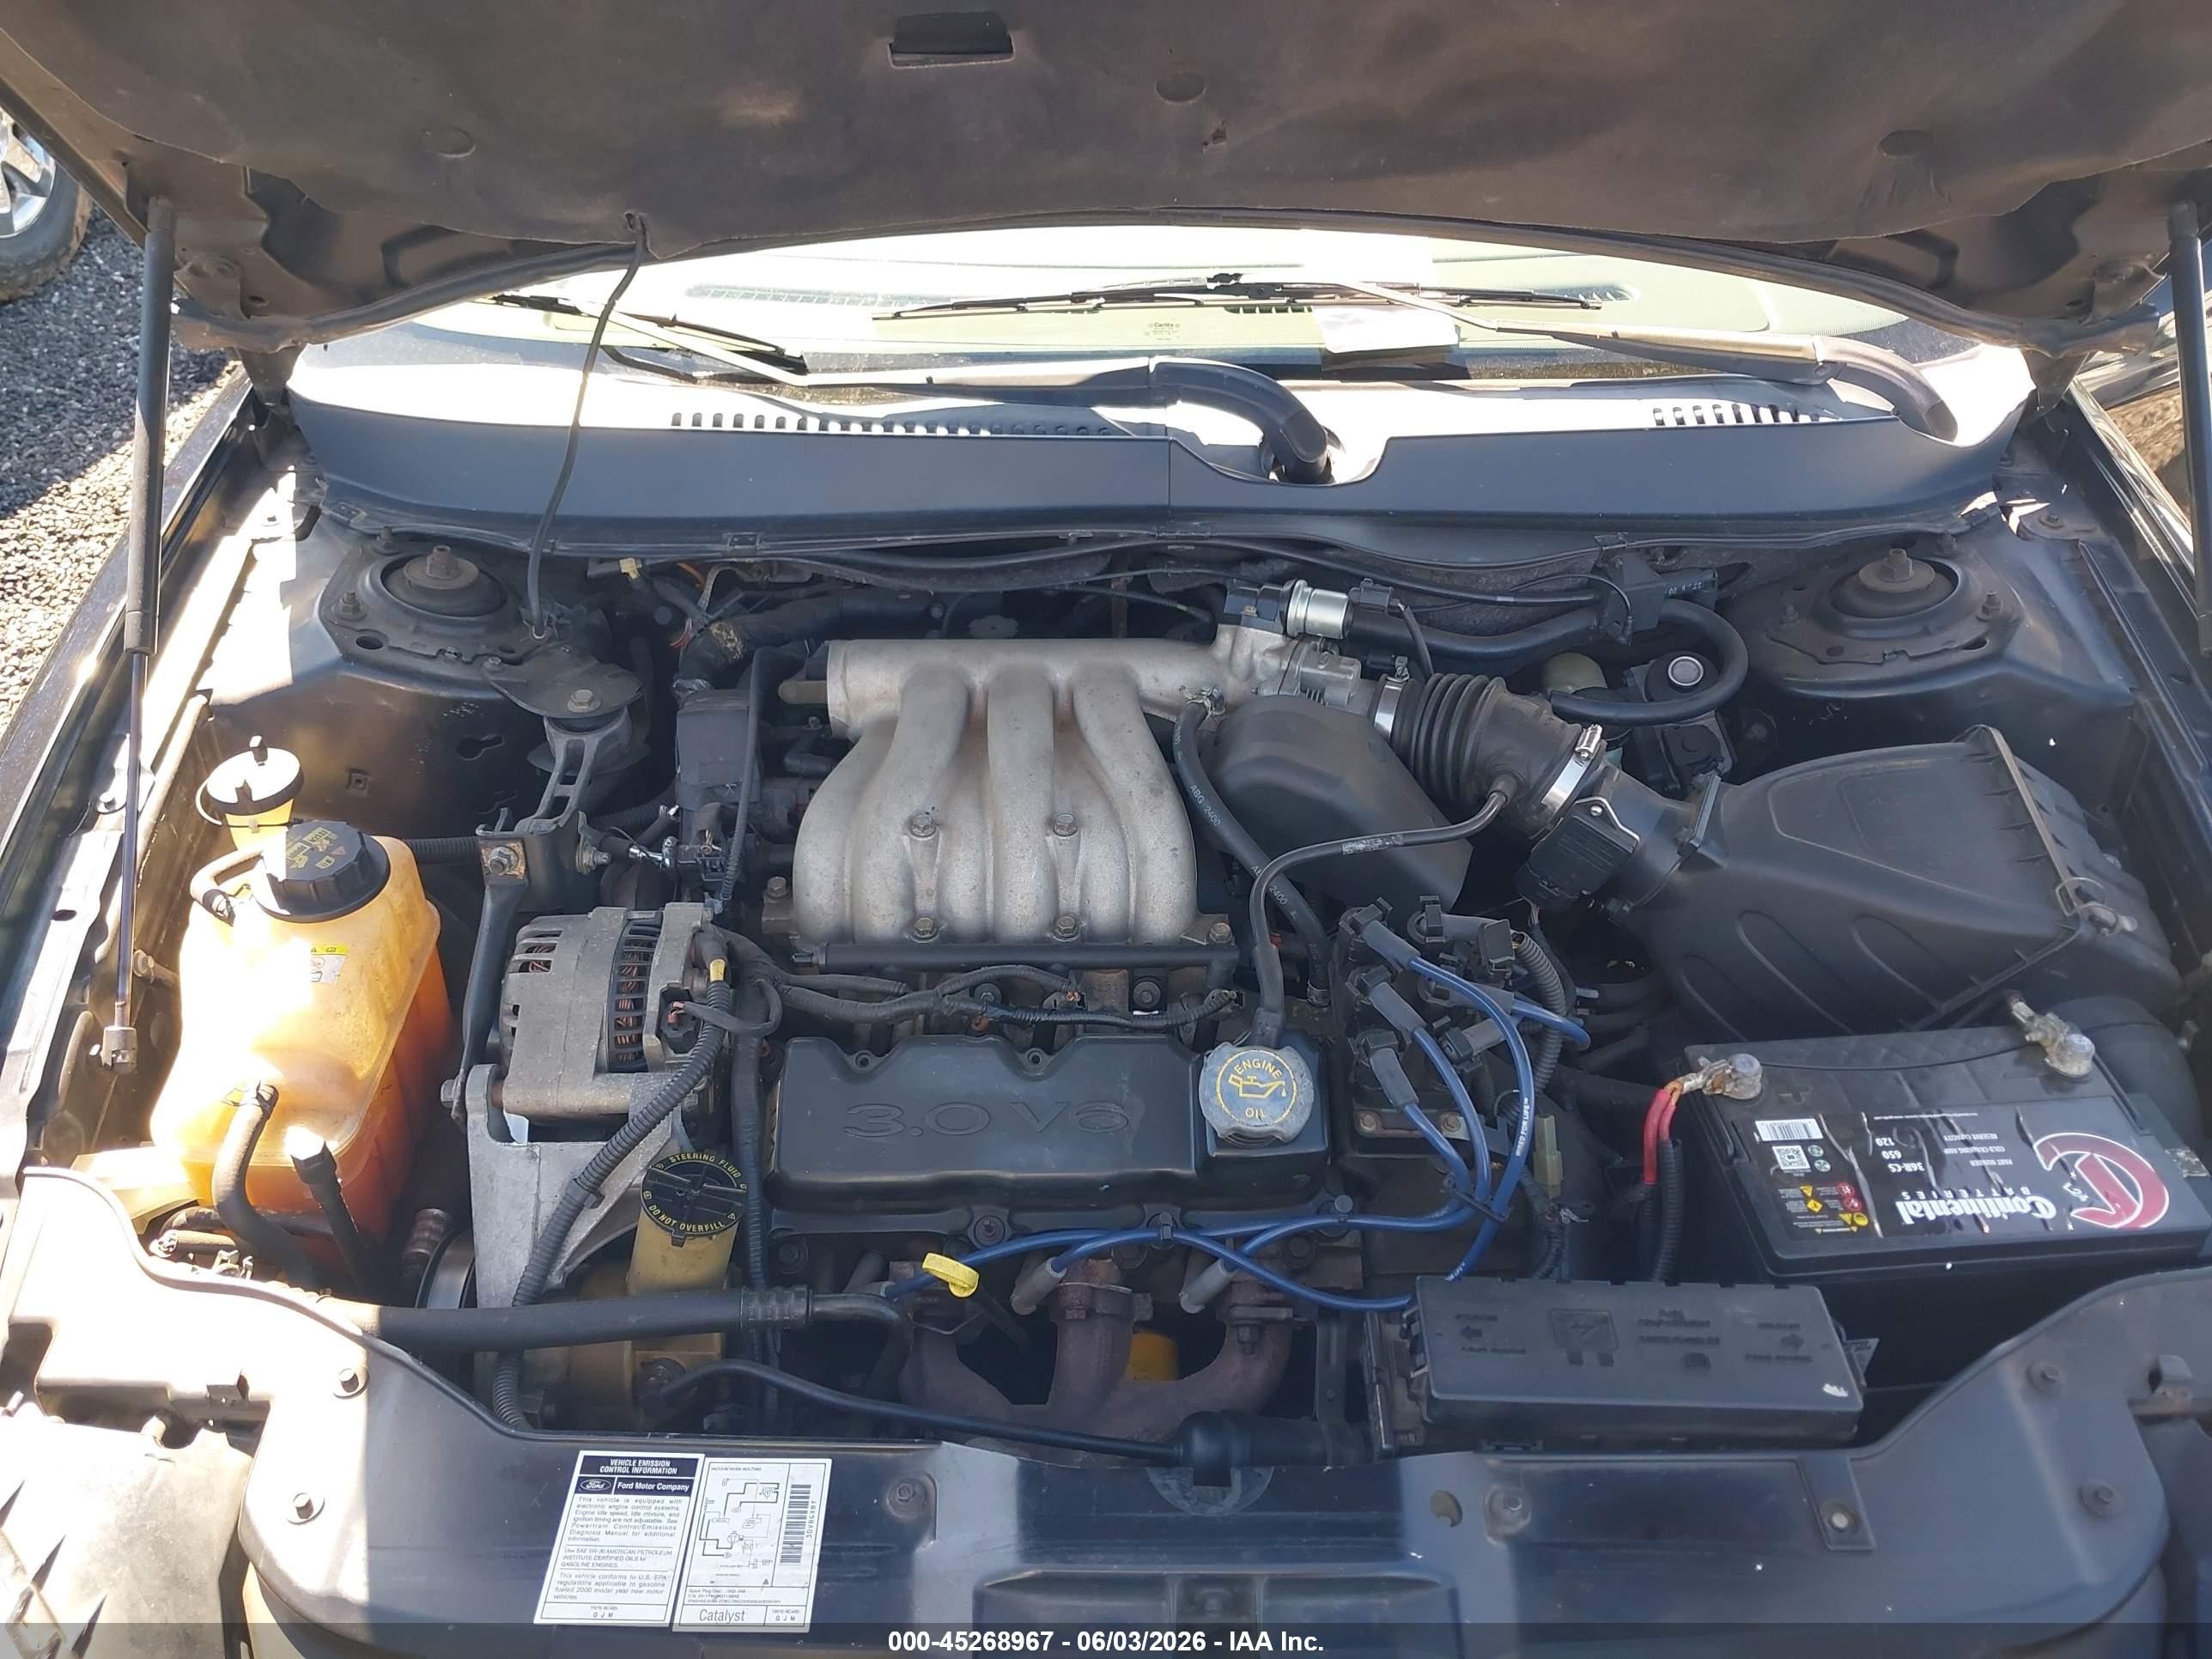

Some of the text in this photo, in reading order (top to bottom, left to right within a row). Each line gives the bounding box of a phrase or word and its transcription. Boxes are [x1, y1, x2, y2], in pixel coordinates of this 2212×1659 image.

[1269, 885, 1288, 906] 2400
[1234, 1058, 1282, 1079] ENGINE
[844, 1101, 1128, 1138] 3.0 V6
[1245, 1107, 1266, 1118] OIL
[1515, 1135, 1526, 1156] WIRED
[1876, 1137, 1895, 1147] 120
[1882, 1150, 1902, 1159] 650
[669, 1153, 741, 1179] STEERING FLUID
[1888, 1162, 1925, 1172] 36R-CS
[1902, 1186, 2031, 1199] BATTERIES
[649, 1204, 725, 1232] DO NOT OVERFILL
[1895, 1196, 2057, 1225] Continental
[586, 1481, 605, 1489] Ford
[656, 1483, 689, 1492] Company
[699, 1608, 745, 1624] Catalyst
